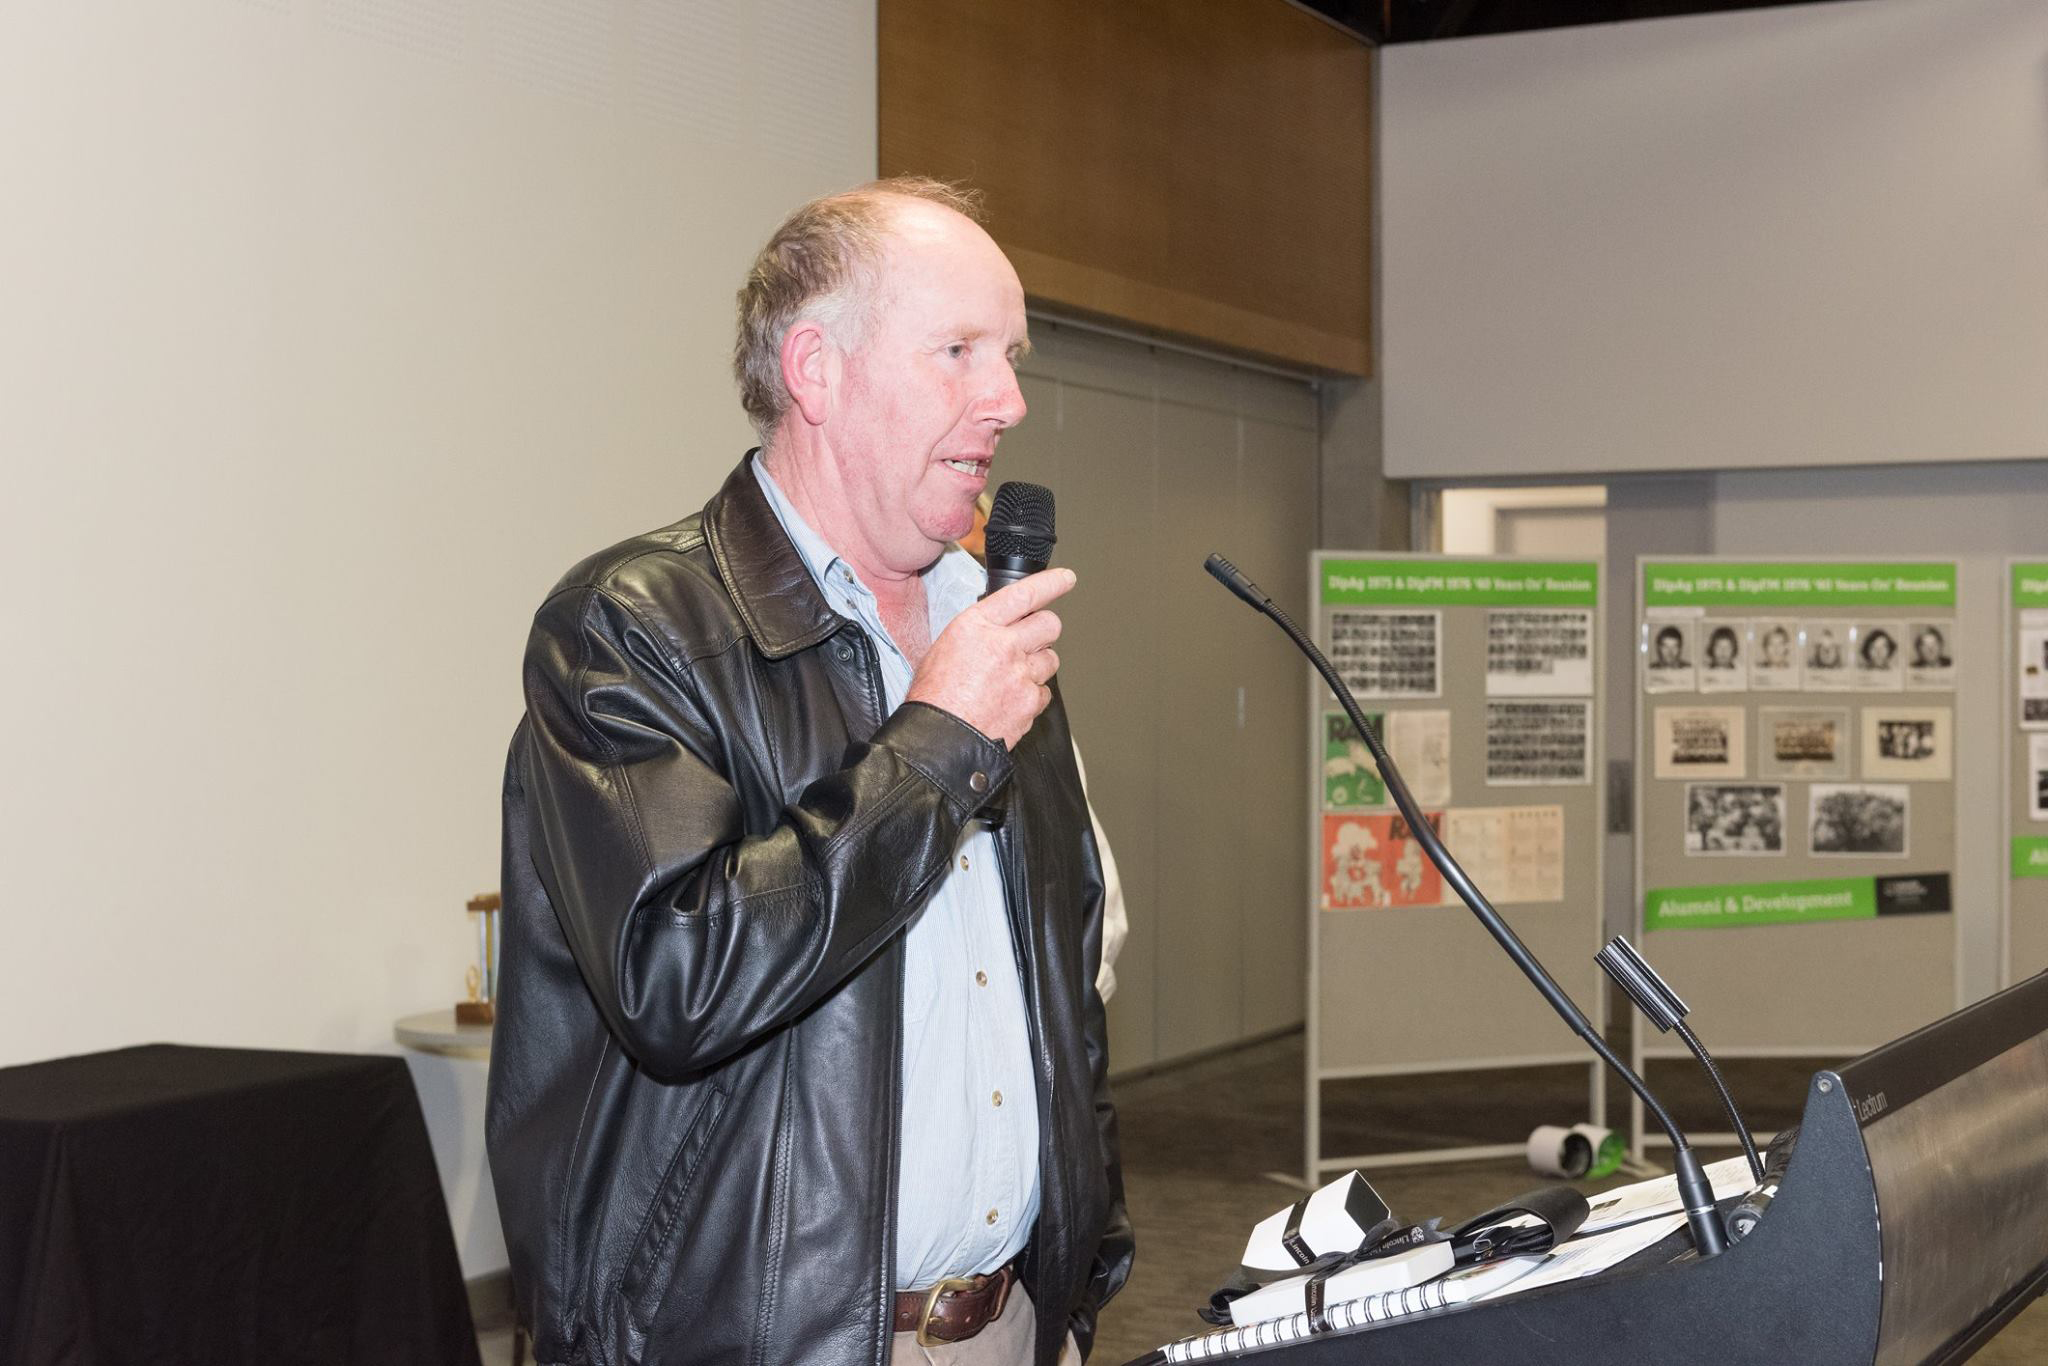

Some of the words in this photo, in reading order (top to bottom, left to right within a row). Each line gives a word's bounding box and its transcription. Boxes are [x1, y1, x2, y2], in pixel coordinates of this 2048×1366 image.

[1658, 897, 1721, 917] Alumni
[1724, 895, 1738, 913] &
[1741, 889, 1853, 913] Development
[1856, 1091, 1888, 1121] Lectrum
[1288, 1238, 1311, 1265] Lincoln
[1382, 1233, 1410, 1249] Lincoln
